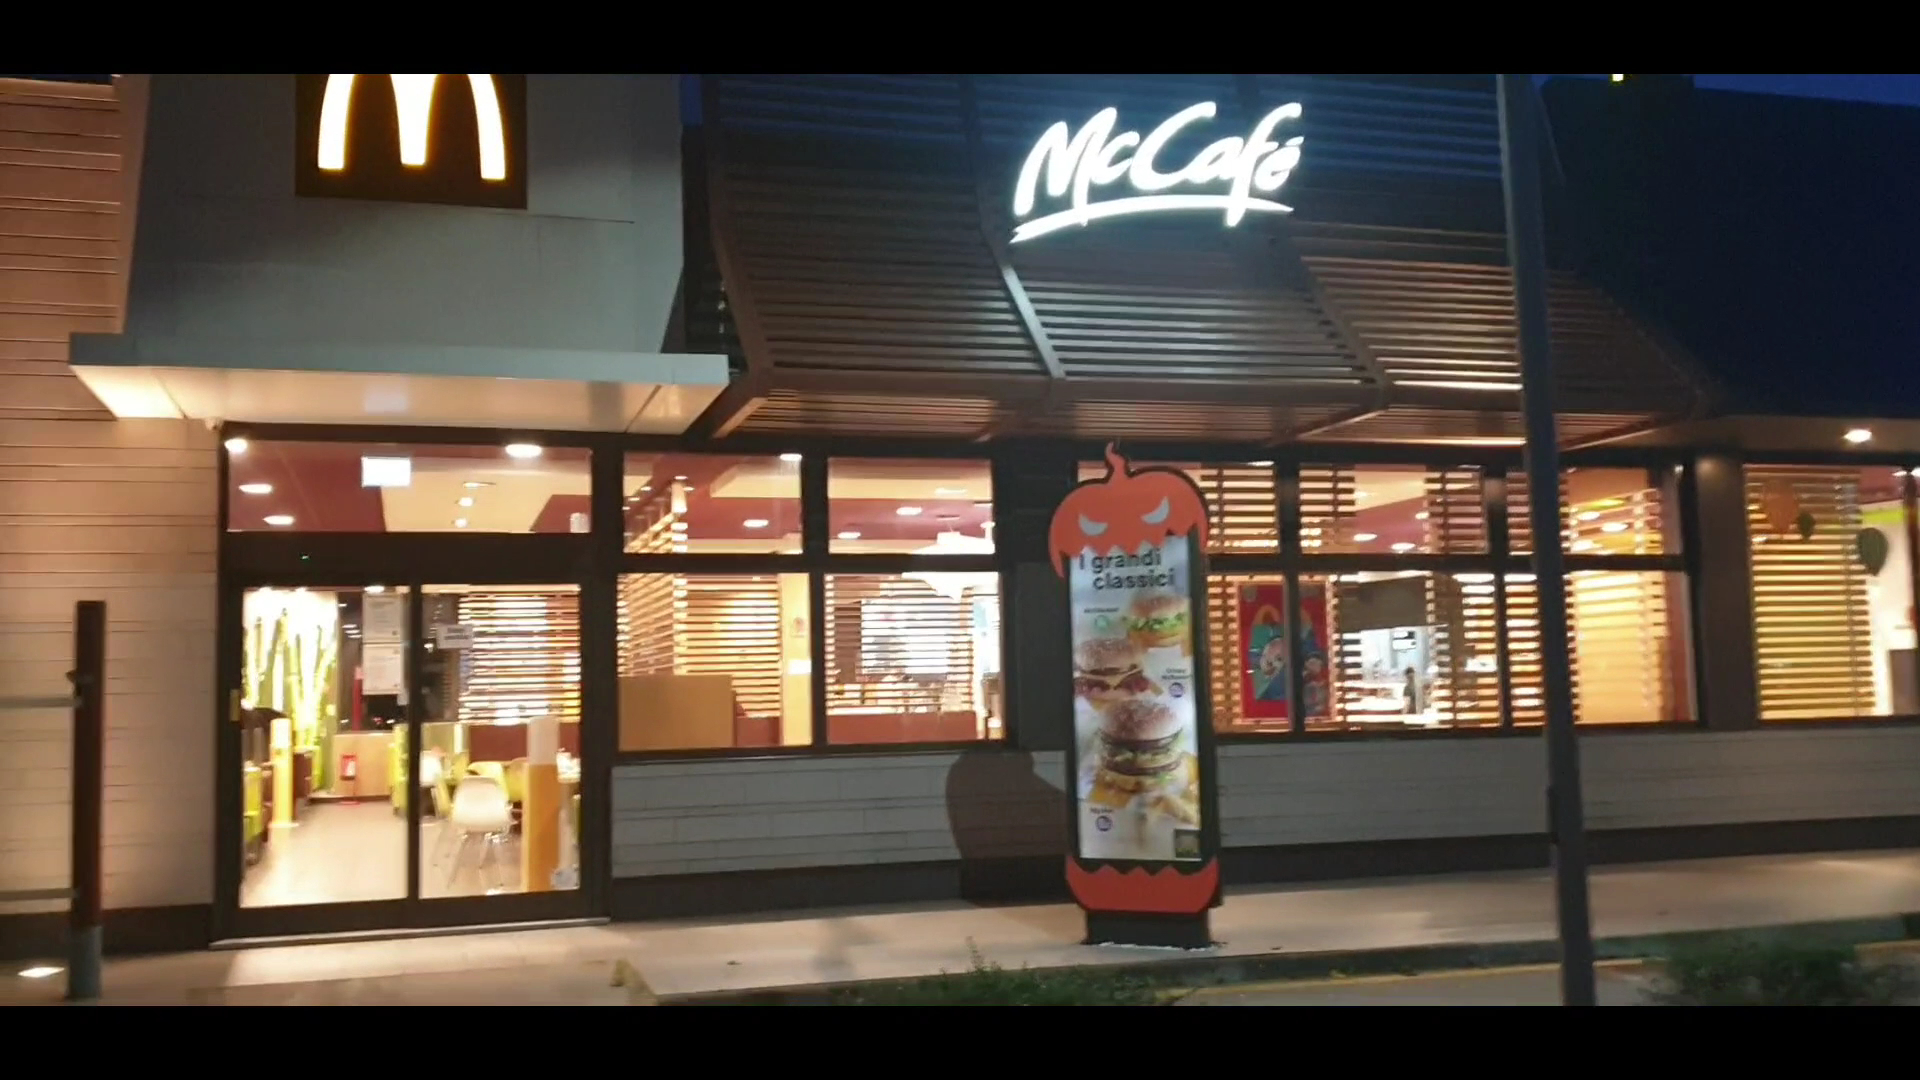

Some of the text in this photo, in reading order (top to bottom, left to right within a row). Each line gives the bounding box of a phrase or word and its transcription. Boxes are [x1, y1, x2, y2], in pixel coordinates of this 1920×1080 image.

[1010, 101, 1304, 230] McCafé
[1091, 547, 1162, 574] grandi
[1093, 567, 1176, 590] classici
